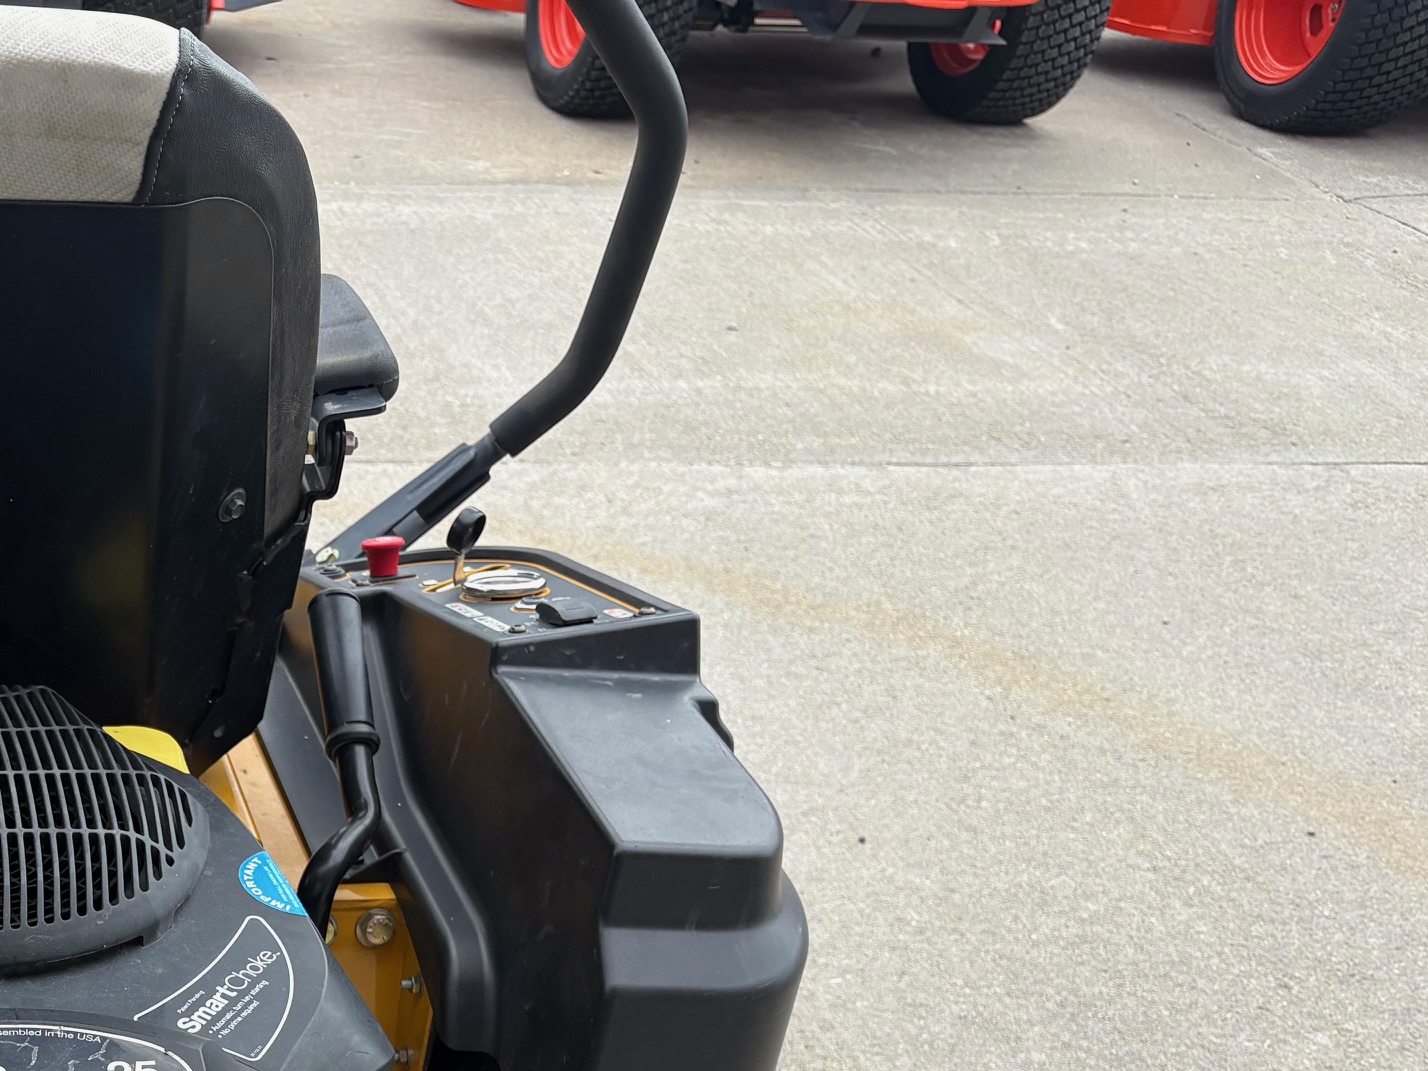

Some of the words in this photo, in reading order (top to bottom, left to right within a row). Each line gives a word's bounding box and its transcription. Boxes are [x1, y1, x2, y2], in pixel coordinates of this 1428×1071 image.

[243, 857, 291, 911] IMPORTANT
[232, 1000, 246, 1011] turn
[250, 980, 270, 996] starting
[219, 1028, 230, 1036] No
[228, 1016, 244, 1030] prime
[240, 1000, 260, 1018] required
[56, 1030, 74, 1039] the
[77, 1032, 102, 1044] USA
